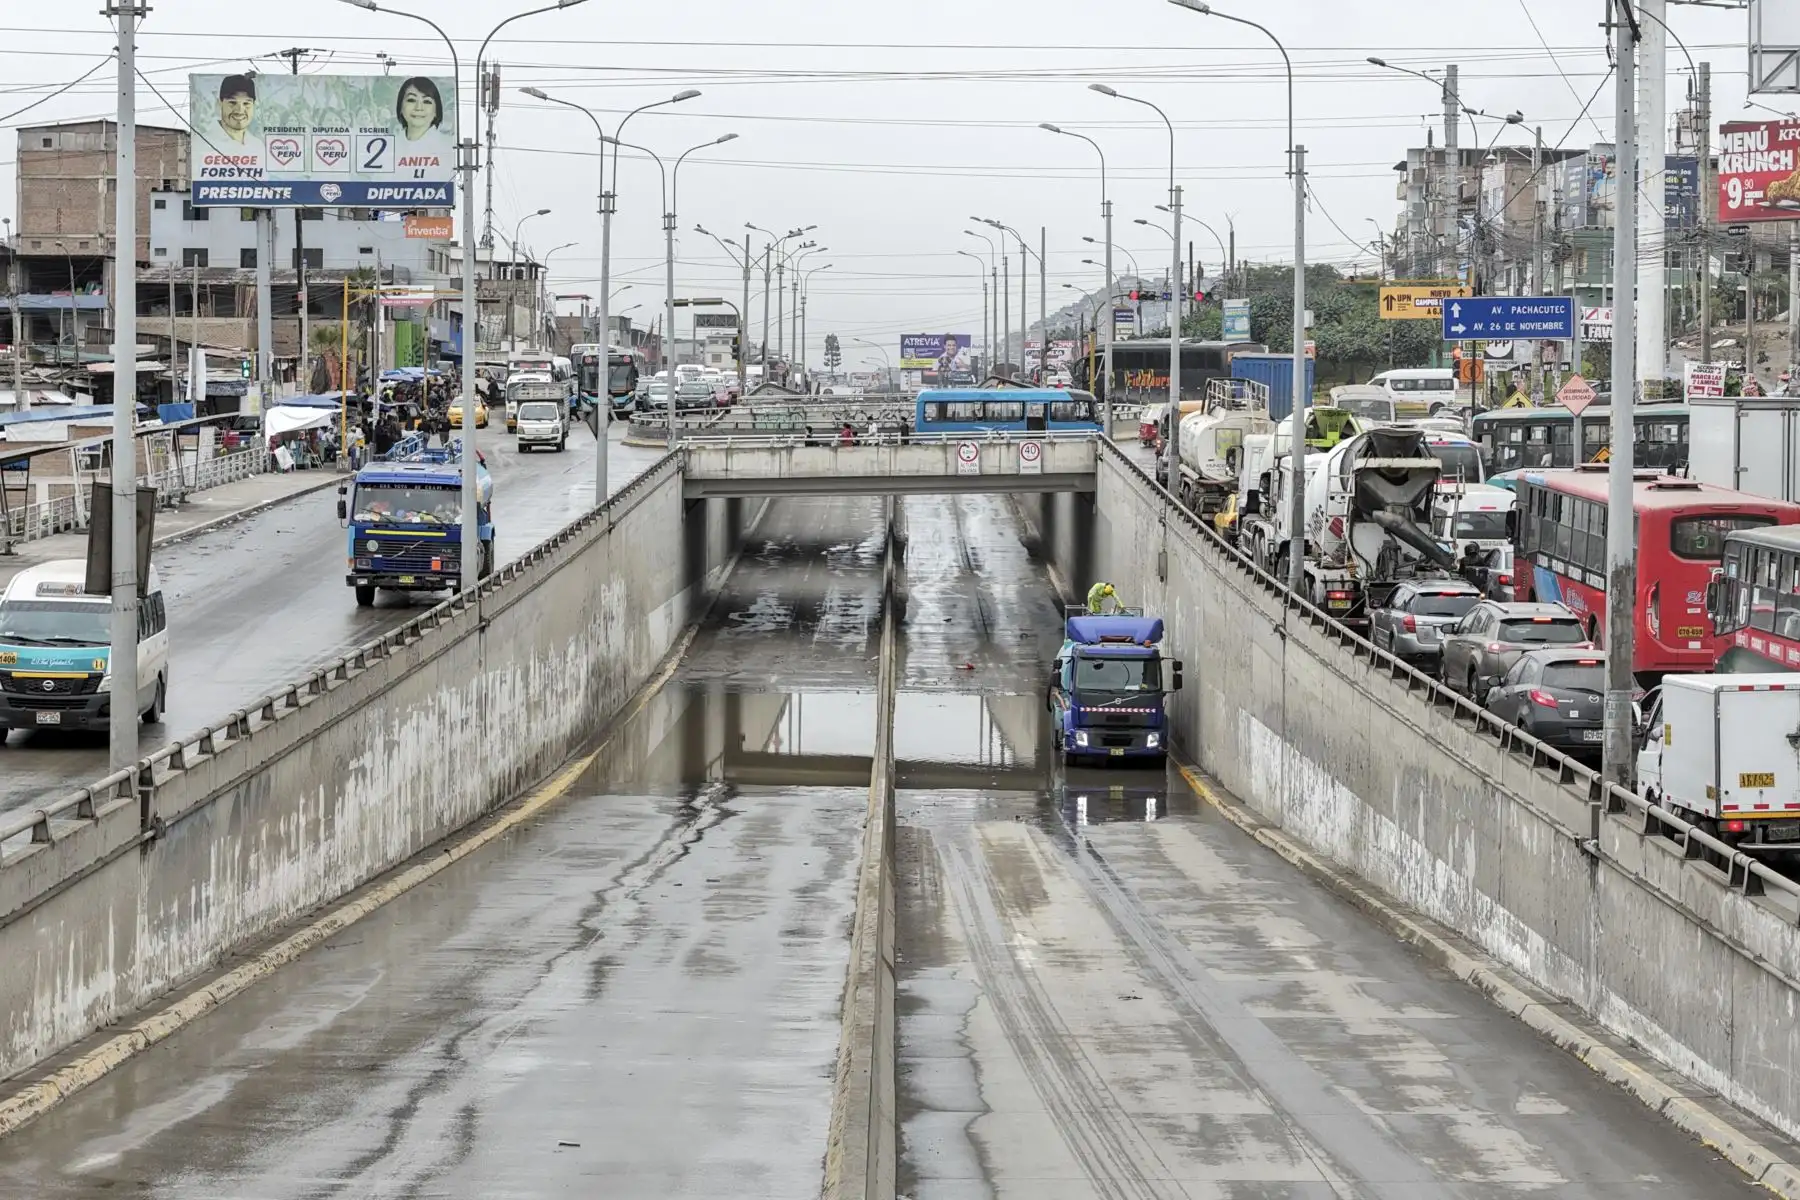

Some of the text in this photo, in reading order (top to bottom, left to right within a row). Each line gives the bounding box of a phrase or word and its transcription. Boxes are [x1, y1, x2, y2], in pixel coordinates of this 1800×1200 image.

[1719, 125, 1768, 153] MENÚ
[363, 137, 388, 169] 2
[203, 155, 258, 166] GEORGE
[397, 156, 440, 167] ANITA
[1718, 150, 1794, 174] KRUNCH
[200, 167, 263, 178] FORSYTH
[413, 168, 425, 178] LI
[199, 186, 293, 200] PRESIDENTE
[366, 187, 447, 200] DIPUTADA
[407, 225, 448, 236] inventa
[1397, 294, 1412, 302] UPN
[1415, 298, 1439, 306] CAMPUS
[1426, 307, 1432, 315] A
[1491, 305, 1566, 315] AV. PACHACUTEC
[1473, 322, 1564, 331] AV. 26 DE NOVIEMBRE
[903, 337, 940, 346] ATREVIA
[1024, 445, 1037, 454] 40
